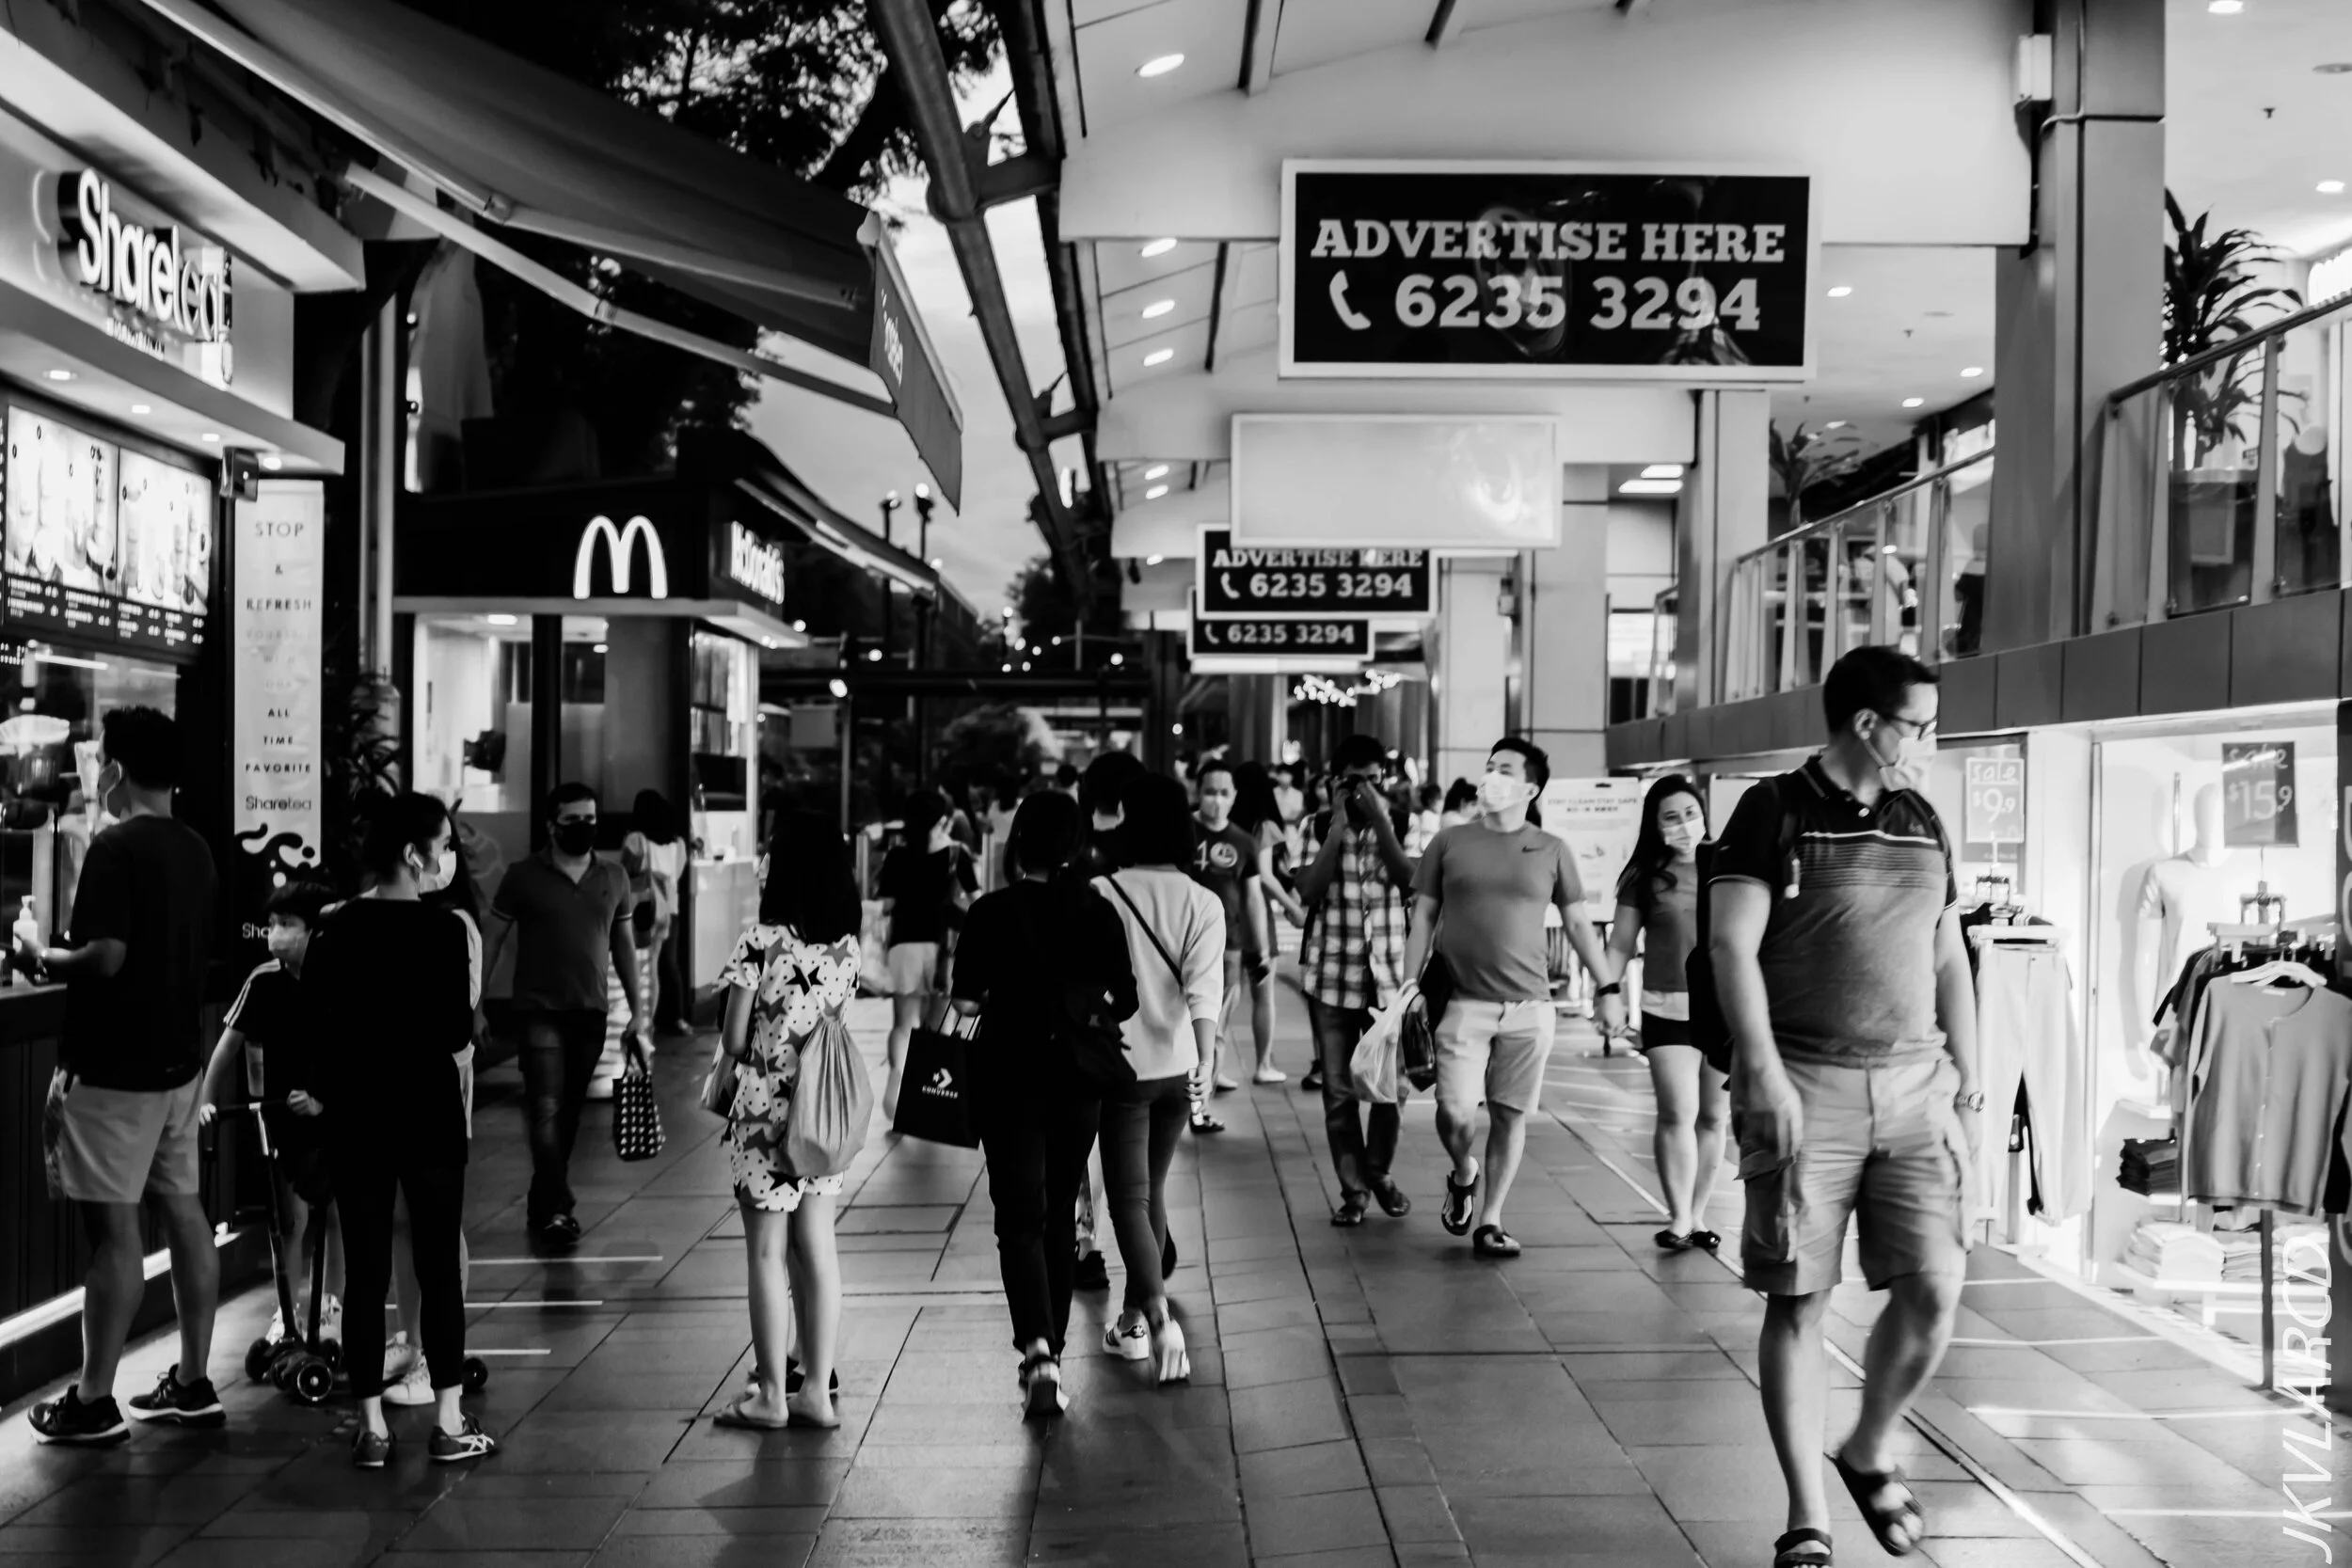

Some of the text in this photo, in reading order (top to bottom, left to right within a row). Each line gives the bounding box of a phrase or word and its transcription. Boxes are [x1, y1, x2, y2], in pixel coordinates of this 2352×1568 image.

[1311, 219, 1786, 262] ADVERTISE HERE
[1395, 274, 1761, 330] 6235 3294
[255, 521, 305, 538] STOP
[1212, 549, 1354, 568] ADVERTISE
[1249, 573, 1413, 598] 6235 3294
[246, 597, 312, 610] REFRESH
[1227, 624, 1356, 645] 6235 3294
[268, 707, 290, 719] ALL
[263, 735, 294, 746] TIME
[246, 762, 311, 774] FAVORITE
[922, 1085, 959, 1099] CONVERSE
